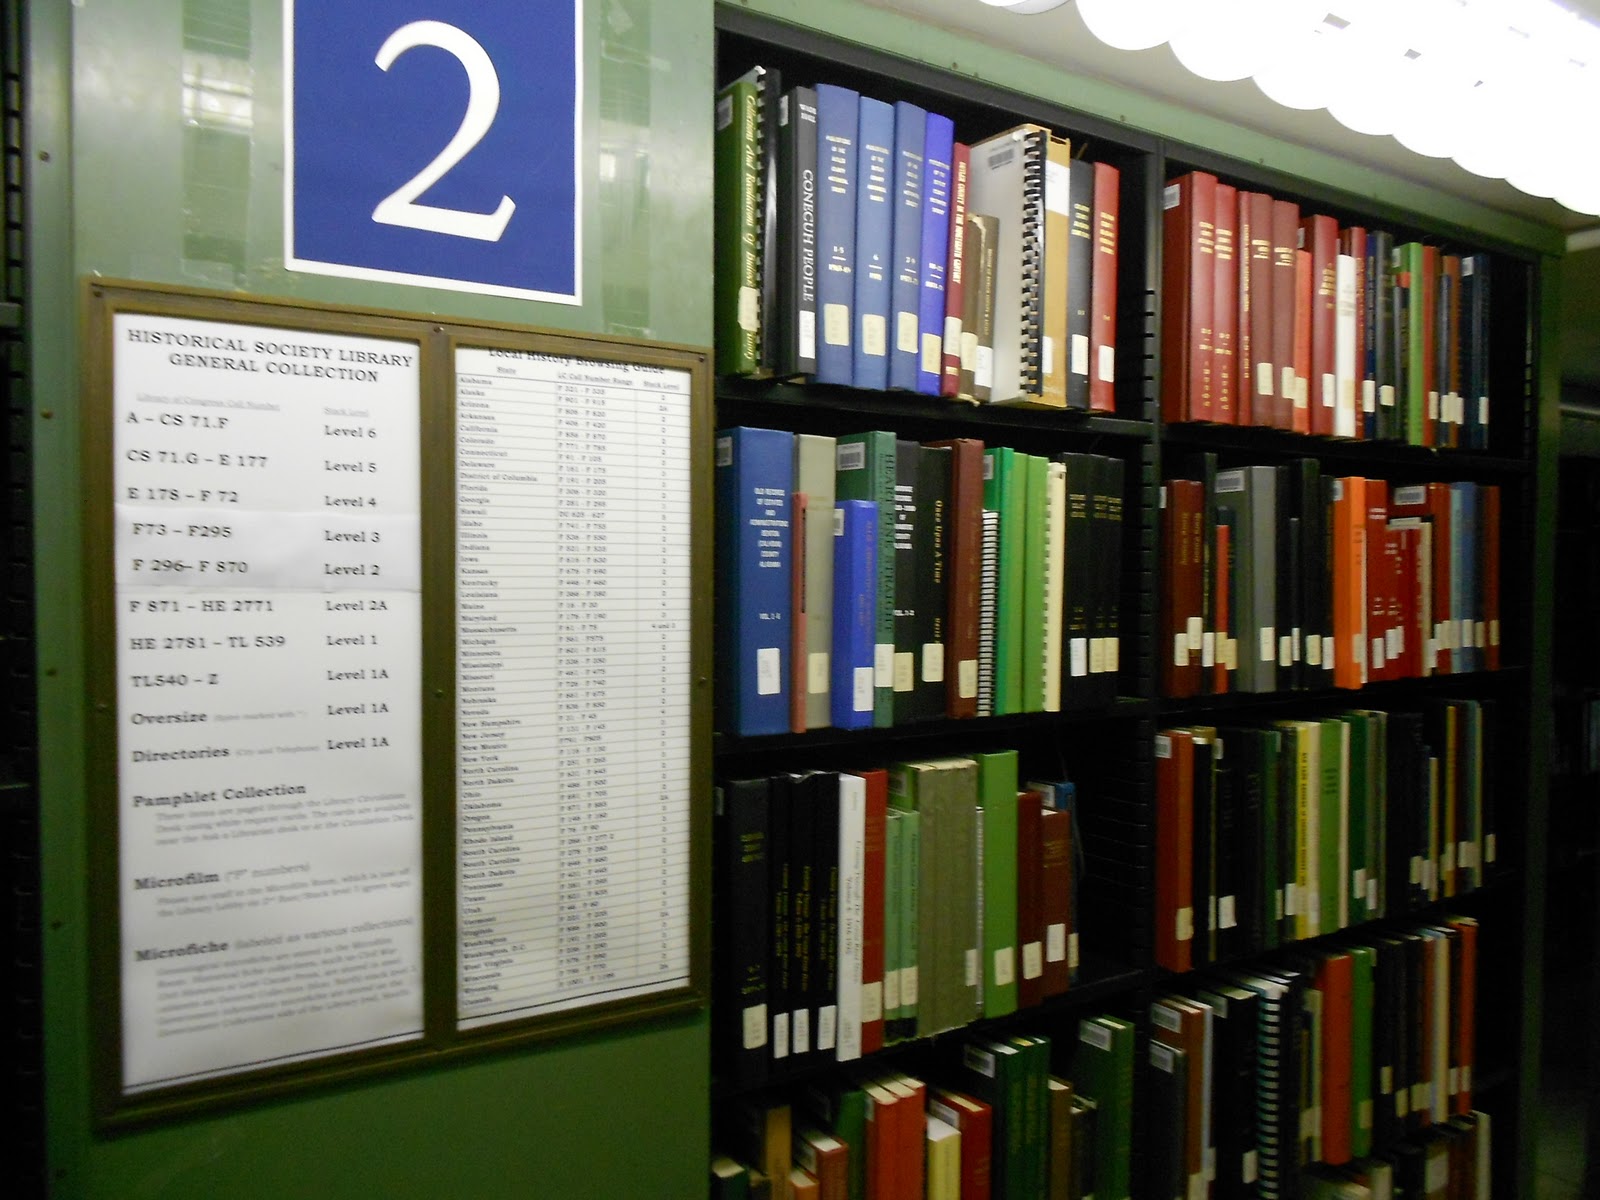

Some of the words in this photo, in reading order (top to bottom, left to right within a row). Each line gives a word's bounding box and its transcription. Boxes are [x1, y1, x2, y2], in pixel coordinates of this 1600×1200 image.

[373, 19, 516, 243] 2
[802, 169, 815, 245] CONECUH
[801, 247, 815, 302] PEOPLE
[128, 330, 247, 352] HISTORICAL
[255, 342, 332, 359] SOCIETY
[338, 350, 412, 369] LIBRARY
[170, 352, 260, 372] GENERAL
[266, 361, 380, 382] COLLECTION
[127, 412, 138, 423] A
[160, 414, 182, 426] CS
[191, 415, 228, 429] 71.F
[325, 425, 363, 437] Level
[368, 429, 376, 438] 6
[127, 450, 150, 462] CS
[158, 451, 198, 464] 71.G
[219, 454, 229, 465] E
[239, 456, 267, 467] 177
[325, 461, 363, 472] Level
[369, 463, 376, 472] 5
[128, 488, 139, 499] E
[149, 489, 179, 500] 178
[201, 490, 211, 501] F
[219, 491, 237, 502] 72
[325, 496, 363, 507] Level
[368, 498, 376, 506] 4
[133, 523, 166, 535] F73
[189, 525, 231, 537] F295
[325, 530, 365, 542] Level
[371, 532, 379, 542] 3
[133, 559, 144, 570] F
[200, 561, 209, 572] F
[216, 561, 247, 573] 870
[325, 564, 365, 575] Level
[371, 565, 379, 575] 2
[130, 601, 140, 612] F
[148, 601, 179, 612] 871
[202, 601, 226, 611] HE
[233, 600, 272, 611] 2771
[326, 601, 364, 611] Level
[370, 601, 387, 610] 2A
[130, 638, 156, 650] HE
[164, 638, 205, 649] 2781
[228, 637, 248, 647] TL
[255, 636, 285, 647] 539
[327, 635, 365, 645] Level
[371, 635, 377, 644] 1
[131, 675, 188, 687] TL540
[209, 674, 218, 684] Z
[327, 670, 365, 680] Level
[372, 669, 389, 679] 1A
[328, 704, 365, 715] Level
[372, 703, 388, 713] 1A
[131, 712, 207, 725] Oversize
[328, 738, 365, 749] Level
[372, 737, 389, 747] 1A
[133, 747, 230, 762] Directories
[133, 792, 217, 808] Pamphlet
[223, 785, 306, 800] Collection
[134, 873, 220, 890] Microfilm
[135, 941, 229, 961] Microfiche
